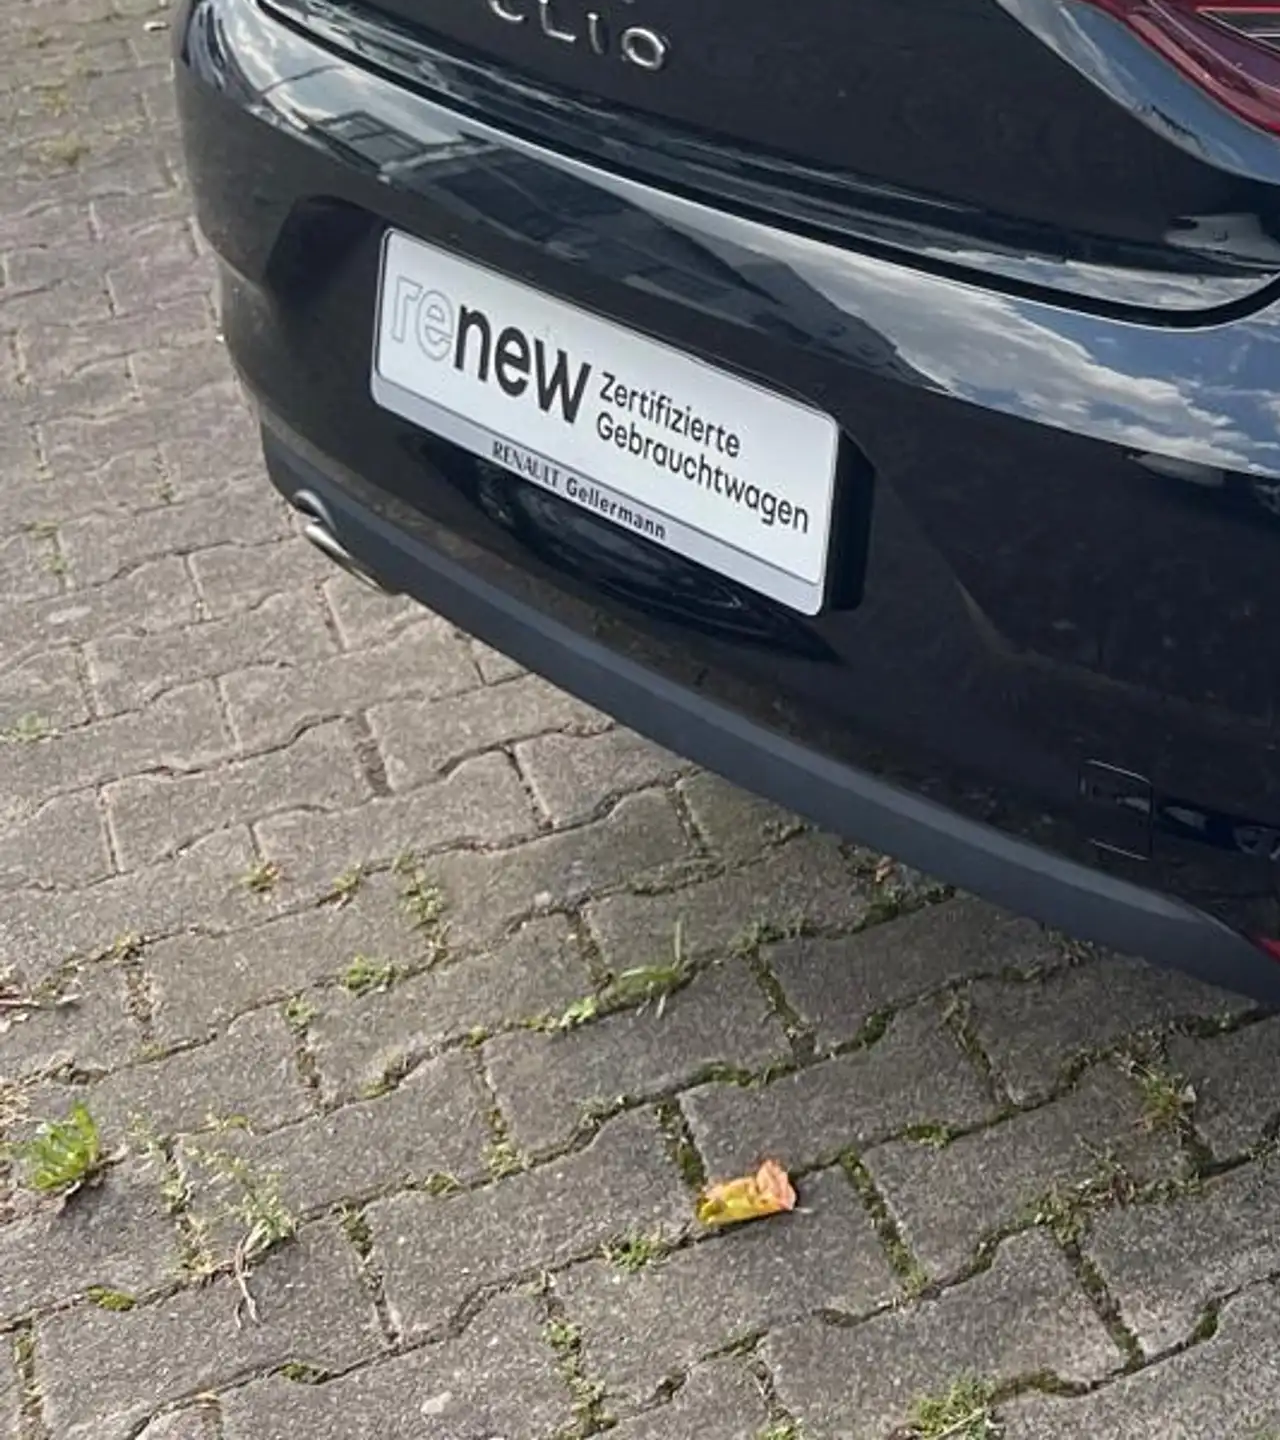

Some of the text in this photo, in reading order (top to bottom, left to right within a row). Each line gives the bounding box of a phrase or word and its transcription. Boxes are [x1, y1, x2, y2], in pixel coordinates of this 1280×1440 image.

[391, 274, 592, 424] renew
[600, 371, 741, 458] Zertifizierte
[492, 440, 667, 542] RENAULT Gellermann
[596, 410, 809, 534] Gebrauchtwagen
